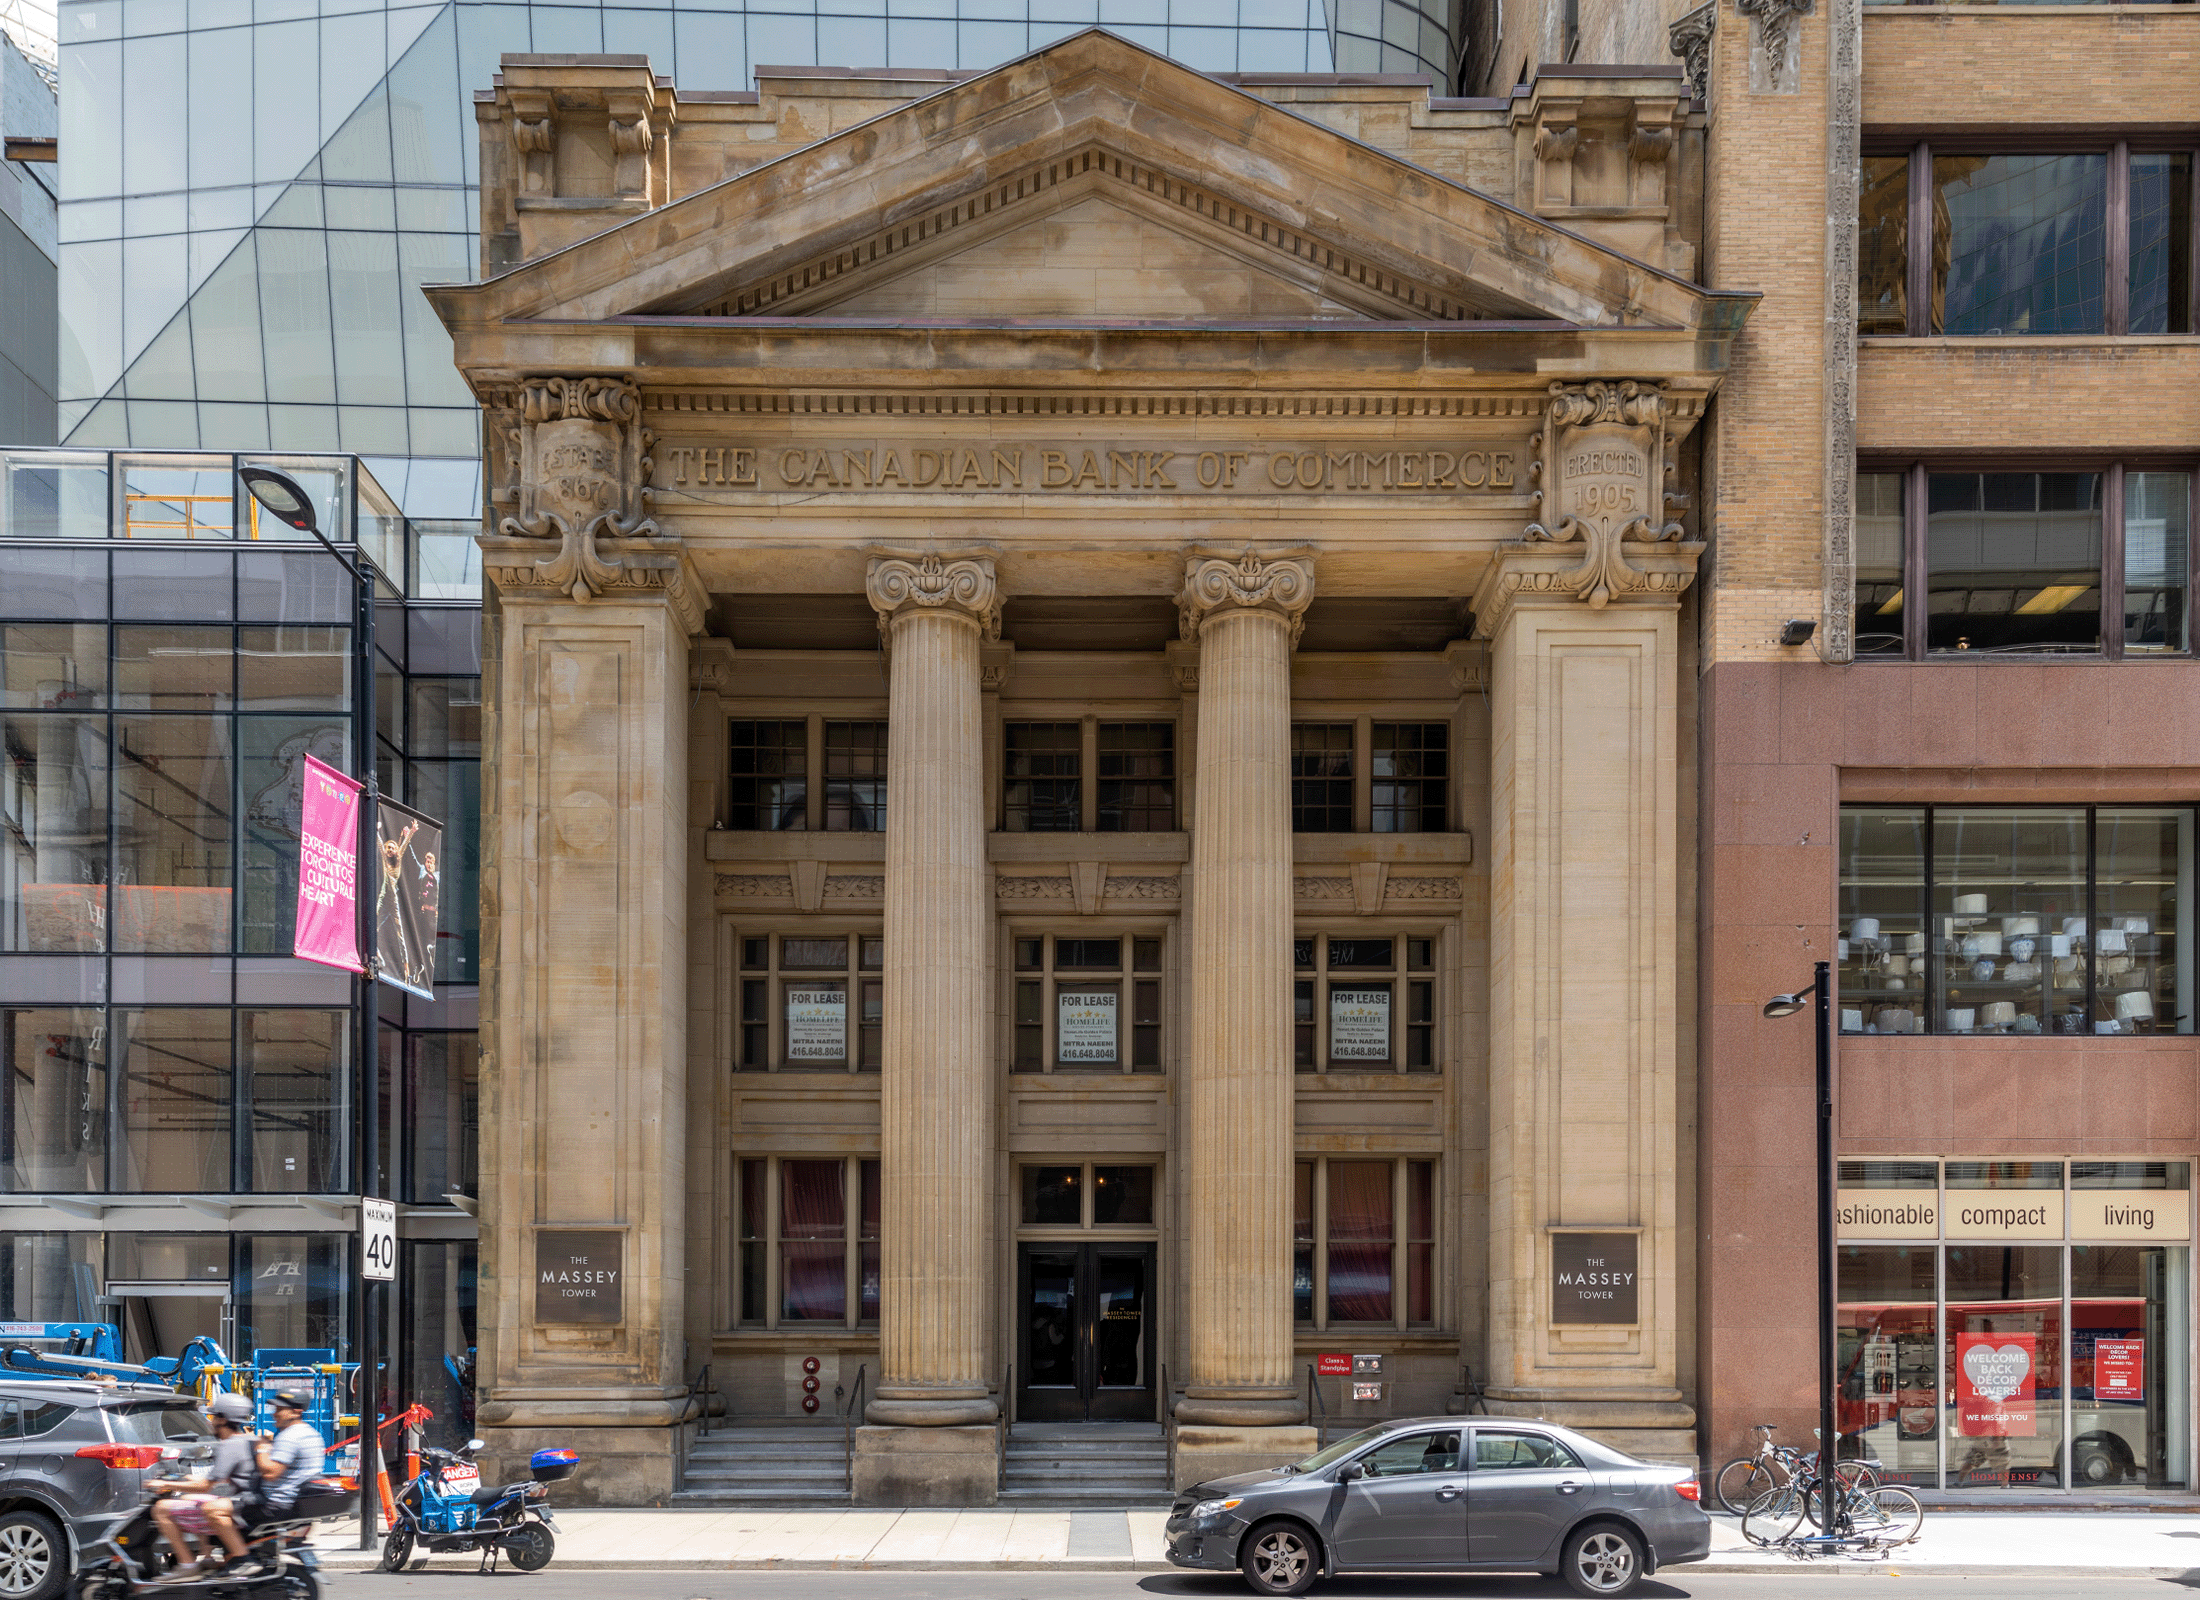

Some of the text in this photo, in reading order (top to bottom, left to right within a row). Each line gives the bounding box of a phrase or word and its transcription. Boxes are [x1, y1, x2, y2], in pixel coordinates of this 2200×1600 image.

[669, 447, 1515, 489] THE CANADIAN BANK OF COMMERCE
[1565, 450, 1645, 479] ERECTED
[307, 869, 356, 901] CULTURAL
[301, 882, 335, 907] HEART
[791, 993, 845, 1004] FOR LEASE
[1062, 996, 1115, 1006] FOR LEASE
[1334, 993, 1387, 1004] FOR LEASE
[791, 1047, 844, 1056] 416.648.8048
[1062, 1049, 1115, 1058] 416.648.8048
[1334, 1046, 1386, 1056] 416.648.8048
[366, 1208, 393, 1223] MAXIMUM
[1961, 1206, 2046, 1229] compact
[2105, 1205, 2154, 1229] living
[367, 1233, 393, 1269] 40
[570, 1256, 588, 1265] THE
[1586, 1258, 1605, 1267] THE
[541, 1270, 617, 1284] MASSEY
[1558, 1272, 1633, 1286] MASSEY
[561, 1289, 597, 1298] TOWER
[1578, 1290, 1613, 1299] TOWER
[1967, 1354, 2026, 1363] WELCOME
[1320, 1364, 1350, 1372] Standpipe
[1981, 1364, 2013, 1374] BACK
[1977, 1373, 2017, 1385] DÉCOR
[1972, 1386, 2021, 1395] LOVERS!
[444, 1467, 477, 1480] ANGER
